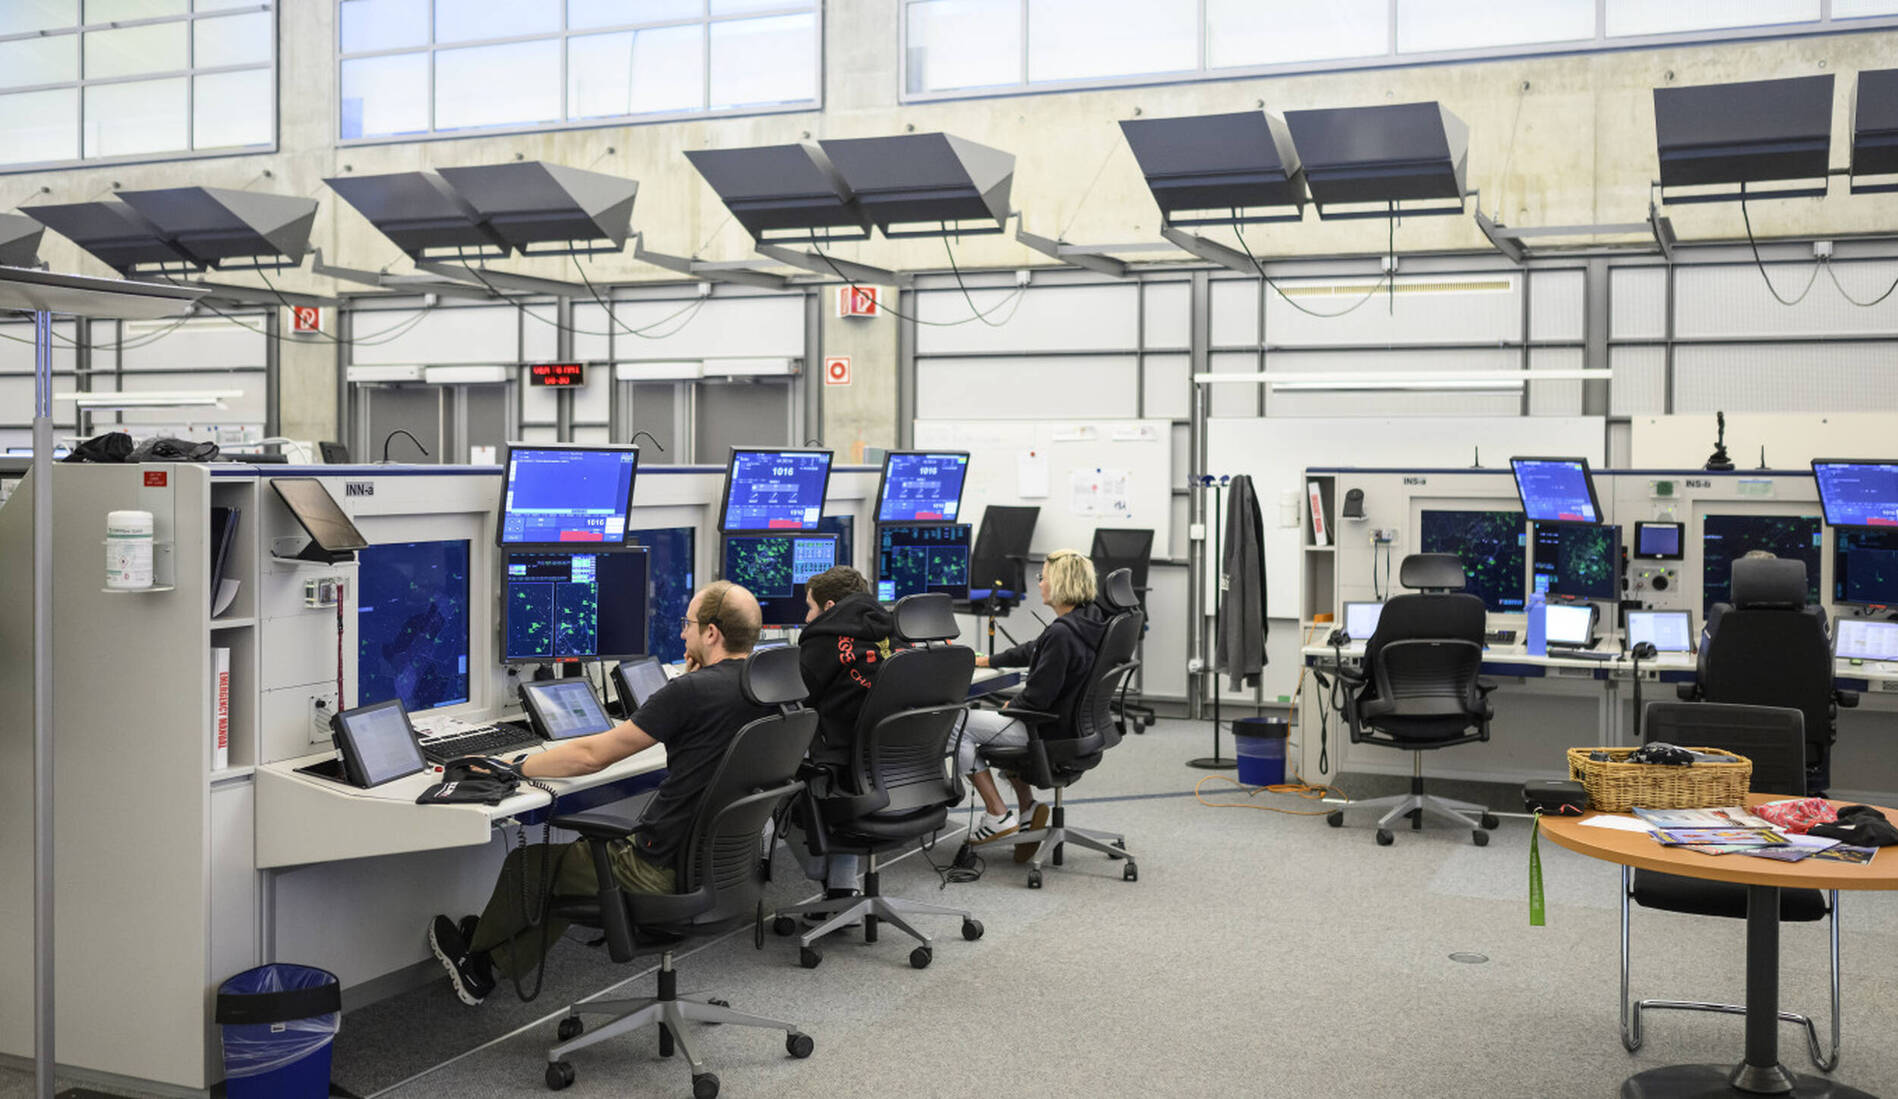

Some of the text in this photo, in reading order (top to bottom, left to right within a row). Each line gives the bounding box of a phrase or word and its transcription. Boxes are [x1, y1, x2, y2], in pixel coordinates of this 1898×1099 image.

[772, 467, 794, 476] 1016
[346, 484, 374, 496] INN-a
[217, 671, 229, 749] EMERGENCY MANUAL
